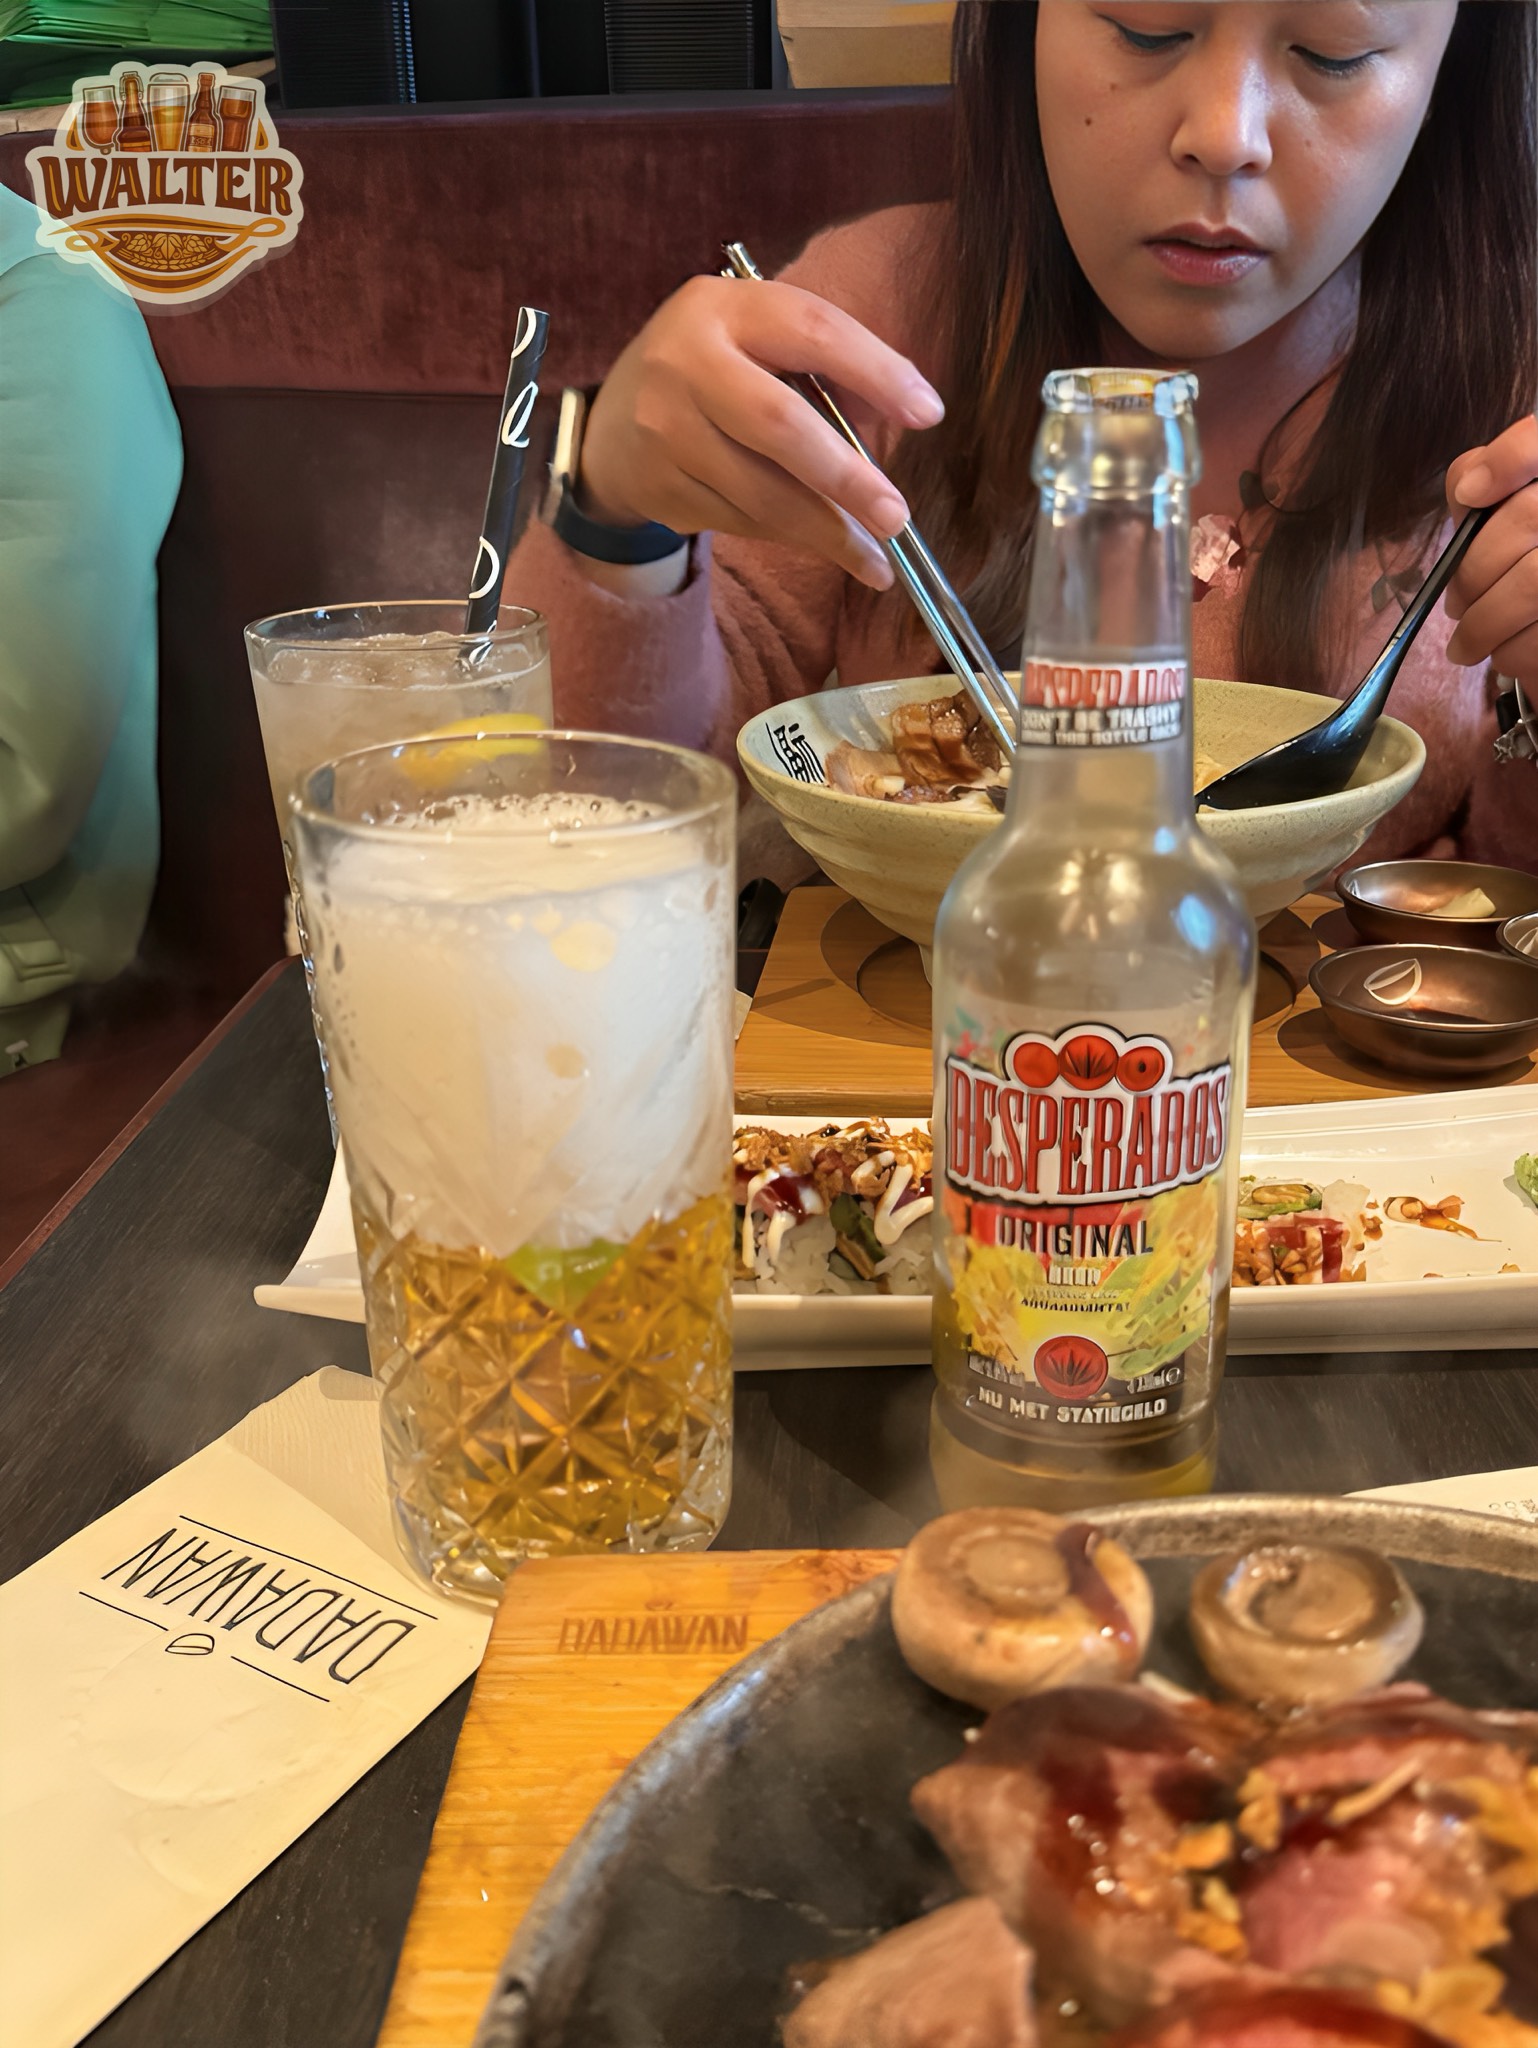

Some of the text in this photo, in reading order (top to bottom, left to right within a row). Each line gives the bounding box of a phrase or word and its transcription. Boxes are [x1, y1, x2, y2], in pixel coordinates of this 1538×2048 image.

[951, 1068, 1227, 1195] DESPERADOS
[996, 1214, 1154, 1258] ORIGINAL
[101, 1528, 416, 1684] DADAWAN
[557, 1615, 748, 1654] DADAWAN
